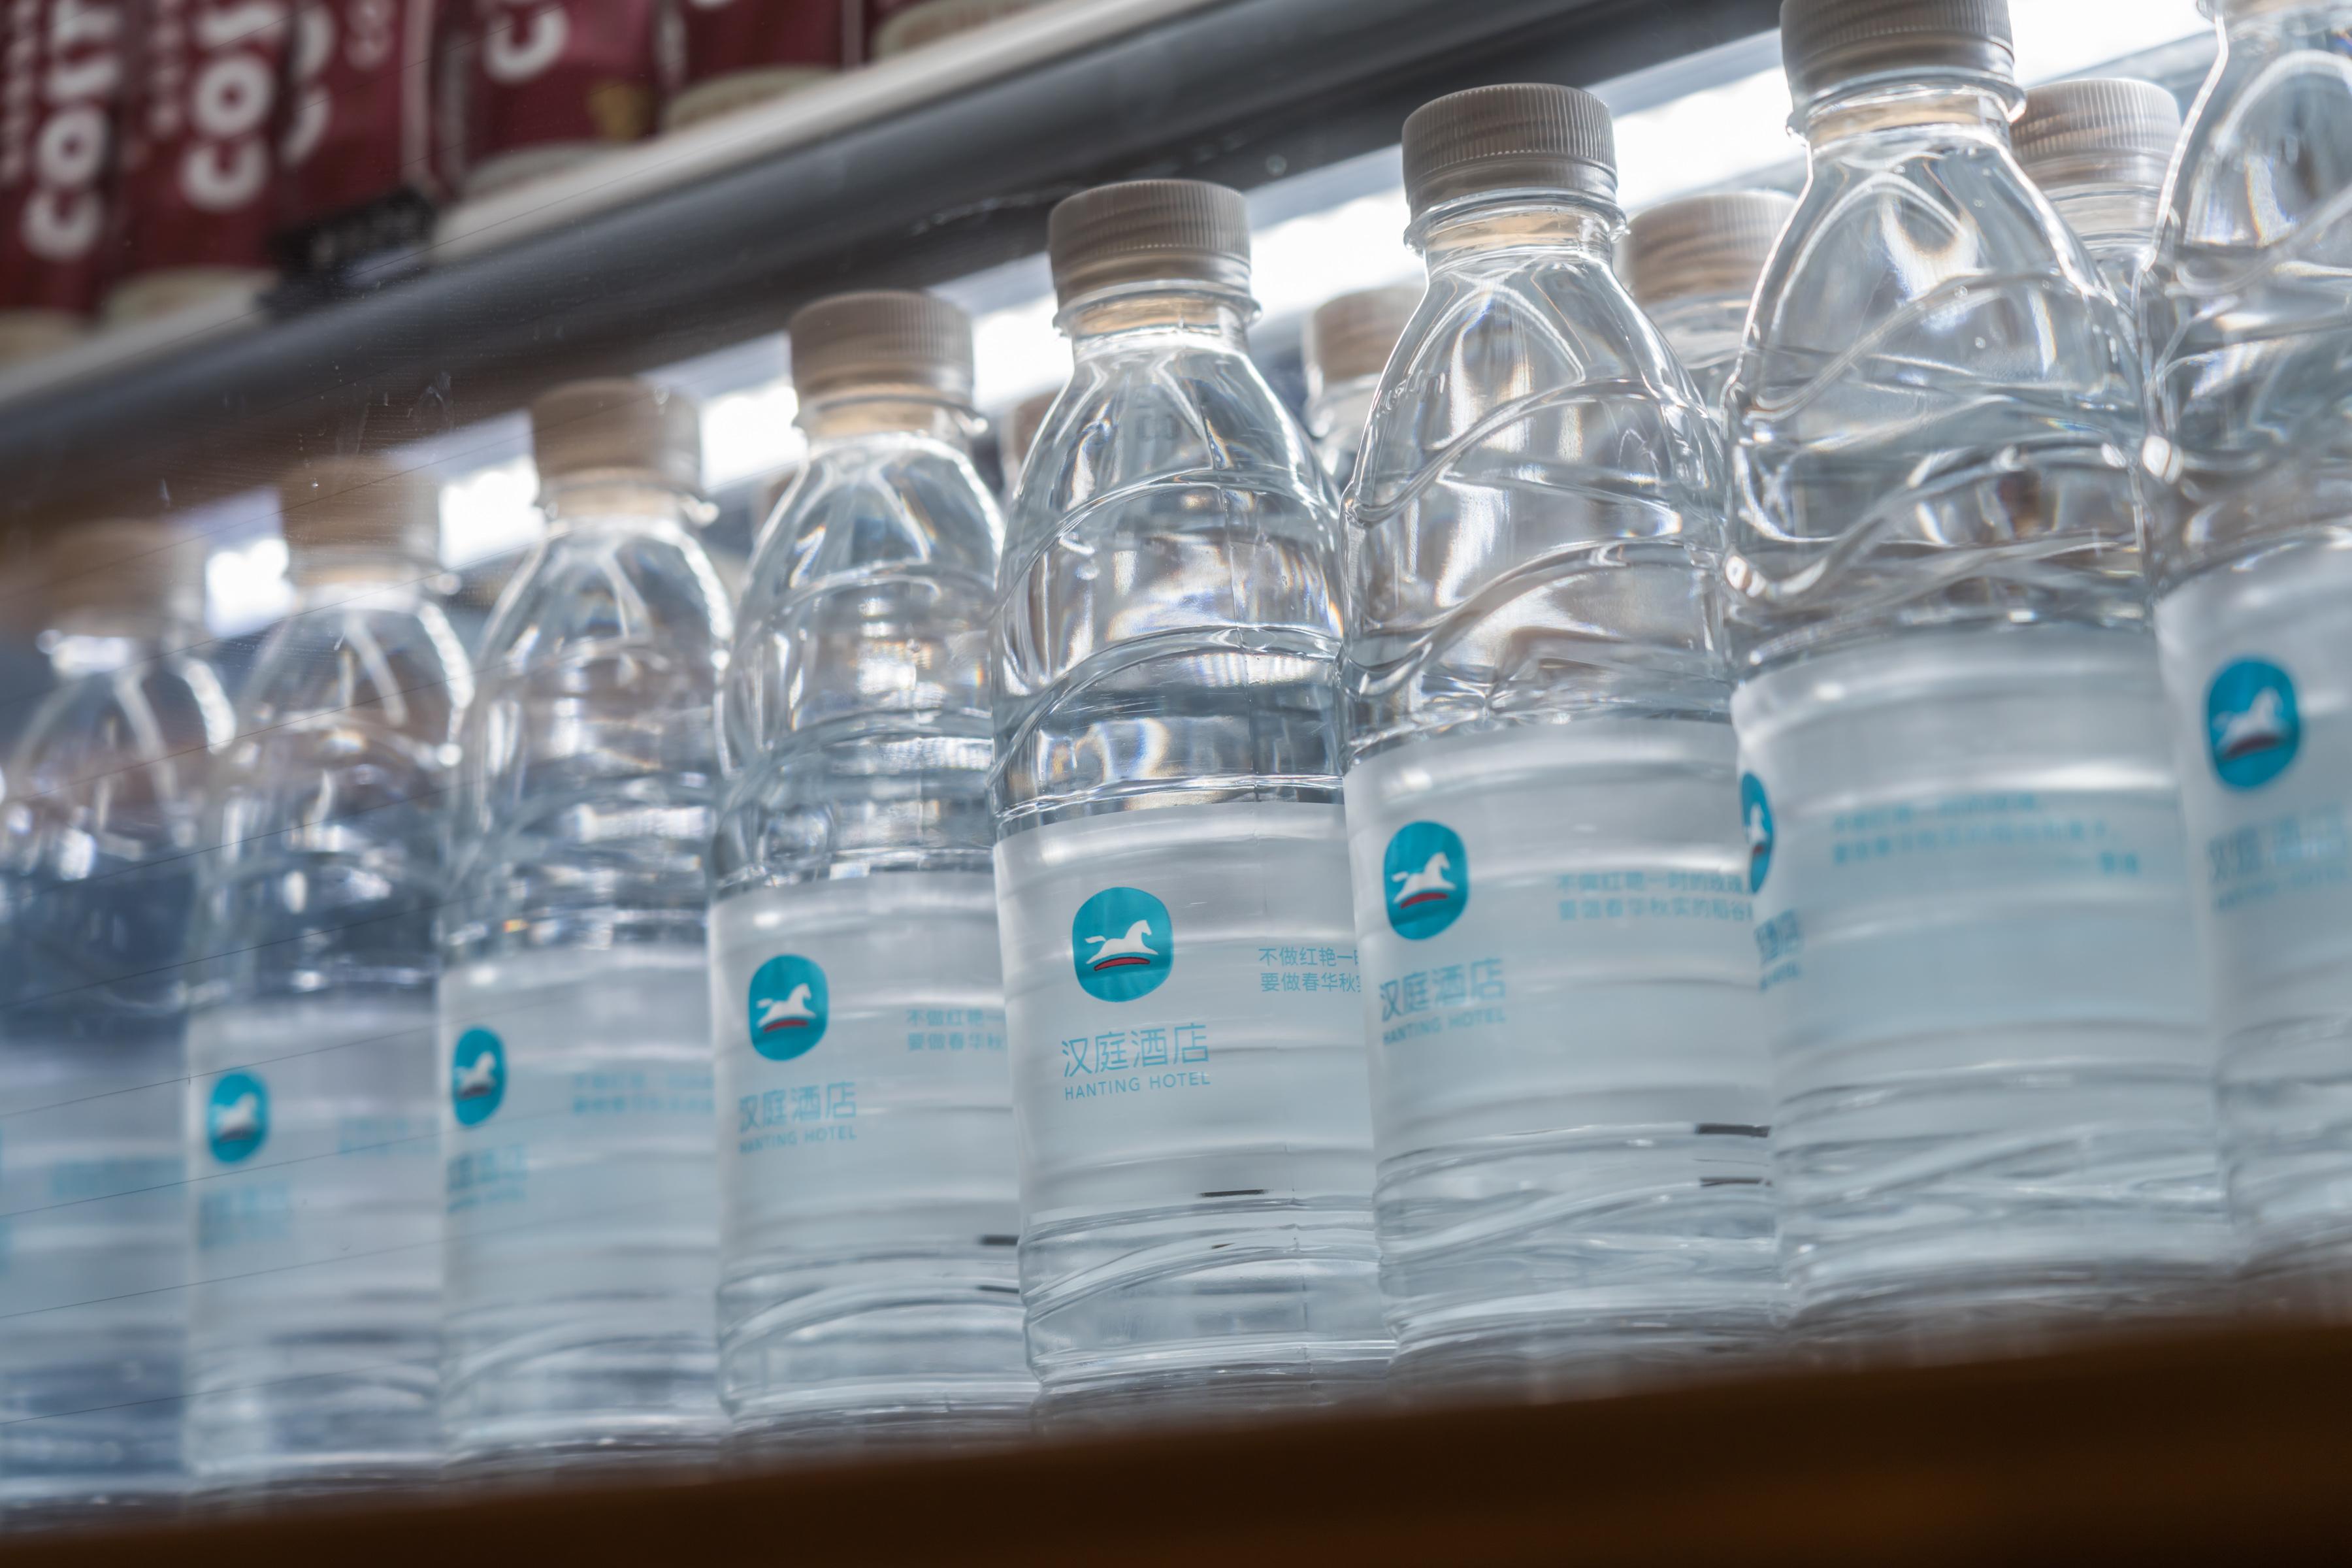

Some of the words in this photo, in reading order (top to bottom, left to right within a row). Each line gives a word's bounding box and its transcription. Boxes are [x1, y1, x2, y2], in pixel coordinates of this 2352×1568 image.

[1379, 957, 1505, 1022] 汉庭酒店
[1061, 1022, 1209, 1078] 汉庭酒店
[1065, 1077, 1141, 1101] HANTING
[1149, 1071, 1211, 1090] HOTEL
